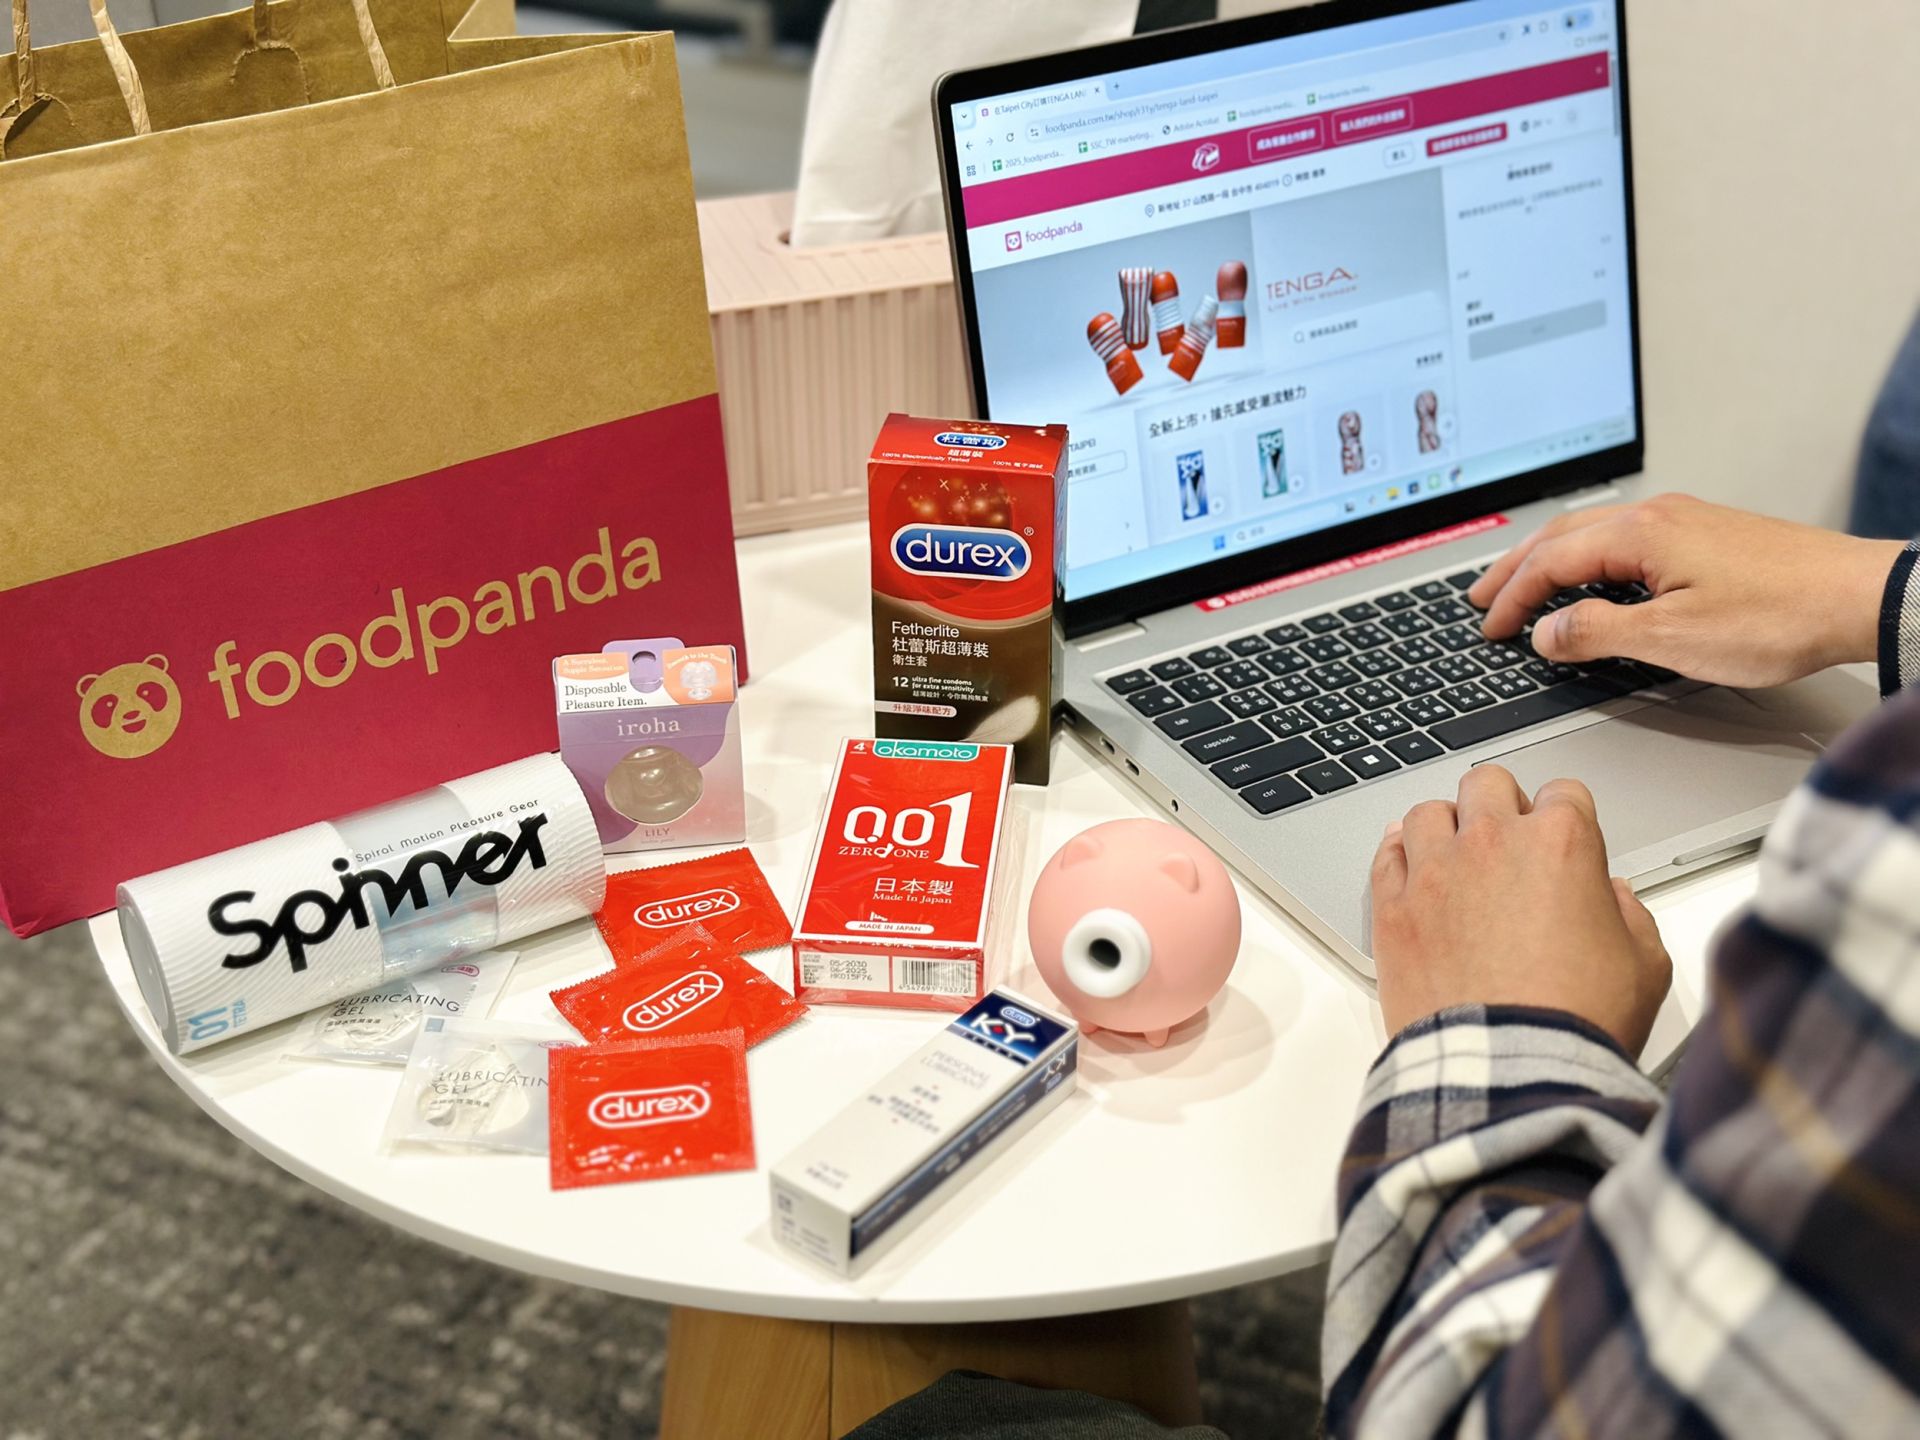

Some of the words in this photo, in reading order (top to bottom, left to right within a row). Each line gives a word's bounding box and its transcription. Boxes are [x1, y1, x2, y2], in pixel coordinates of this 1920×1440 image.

[1026, 220, 1083, 243] foodpanda
[1266, 267, 1353, 300] TENGA
[905, 532, 1018, 569] durex
[208, 526, 662, 719] foodpanda
[891, 621, 960, 638] Fetherlite
[892, 636, 989, 658] 杜蕾斯超薄裝
[892, 654, 928, 667] 衛生套
[892, 676, 909, 688] 12
[941, 684, 975, 694] sensitivity
[1271, 681, 1286, 690] W
[565, 682, 627, 697] Disposable
[1354, 687, 1366, 695] D
[565, 699, 615, 711] Pleasure
[617, 696, 647, 707] Item.
[1230, 695, 1243, 703] Q
[1312, 700, 1324, 708] S
[1406, 702, 1419, 710] C
[1271, 714, 1283, 723] A
[1363, 715, 1376, 724] X
[617, 717, 681, 736] iroha
[1320, 730, 1332, 739] Z
[1203, 737, 1221, 749] caps
[1220, 735, 1236, 745] lock
[853, 742, 866, 751] 4
[878, 741, 973, 759] okamoto
[1233, 763, 1250, 773] shift
[1262, 788, 1276, 798] ctrl
[355, 844, 394, 863] Spiral
[400, 829, 444, 848] Motion
[450, 810, 504, 833] Pleasure
[509, 800, 539, 813] Gear
[645, 828, 670, 837] LILY
[894, 849, 930, 859] ONE
[207, 812, 548, 973] Spinner
[875, 877, 954, 896] 日本製
[873, 893, 903, 902] Made
[906, 894, 918, 902] In
[919, 895, 952, 904] Japan
[646, 894, 732, 922] durex
[830, 959, 868, 968] 05/2030
[830, 966, 868, 974] 06/2025
[339, 993, 461, 1012] LUBRICATING
[635, 977, 720, 1024] durex
[334, 1006, 365, 1017] GEL
[188, 1007, 229, 1041] 01
[439, 1069, 549, 1088] LUBRICATIN
[601, 1093, 702, 1120] durex
